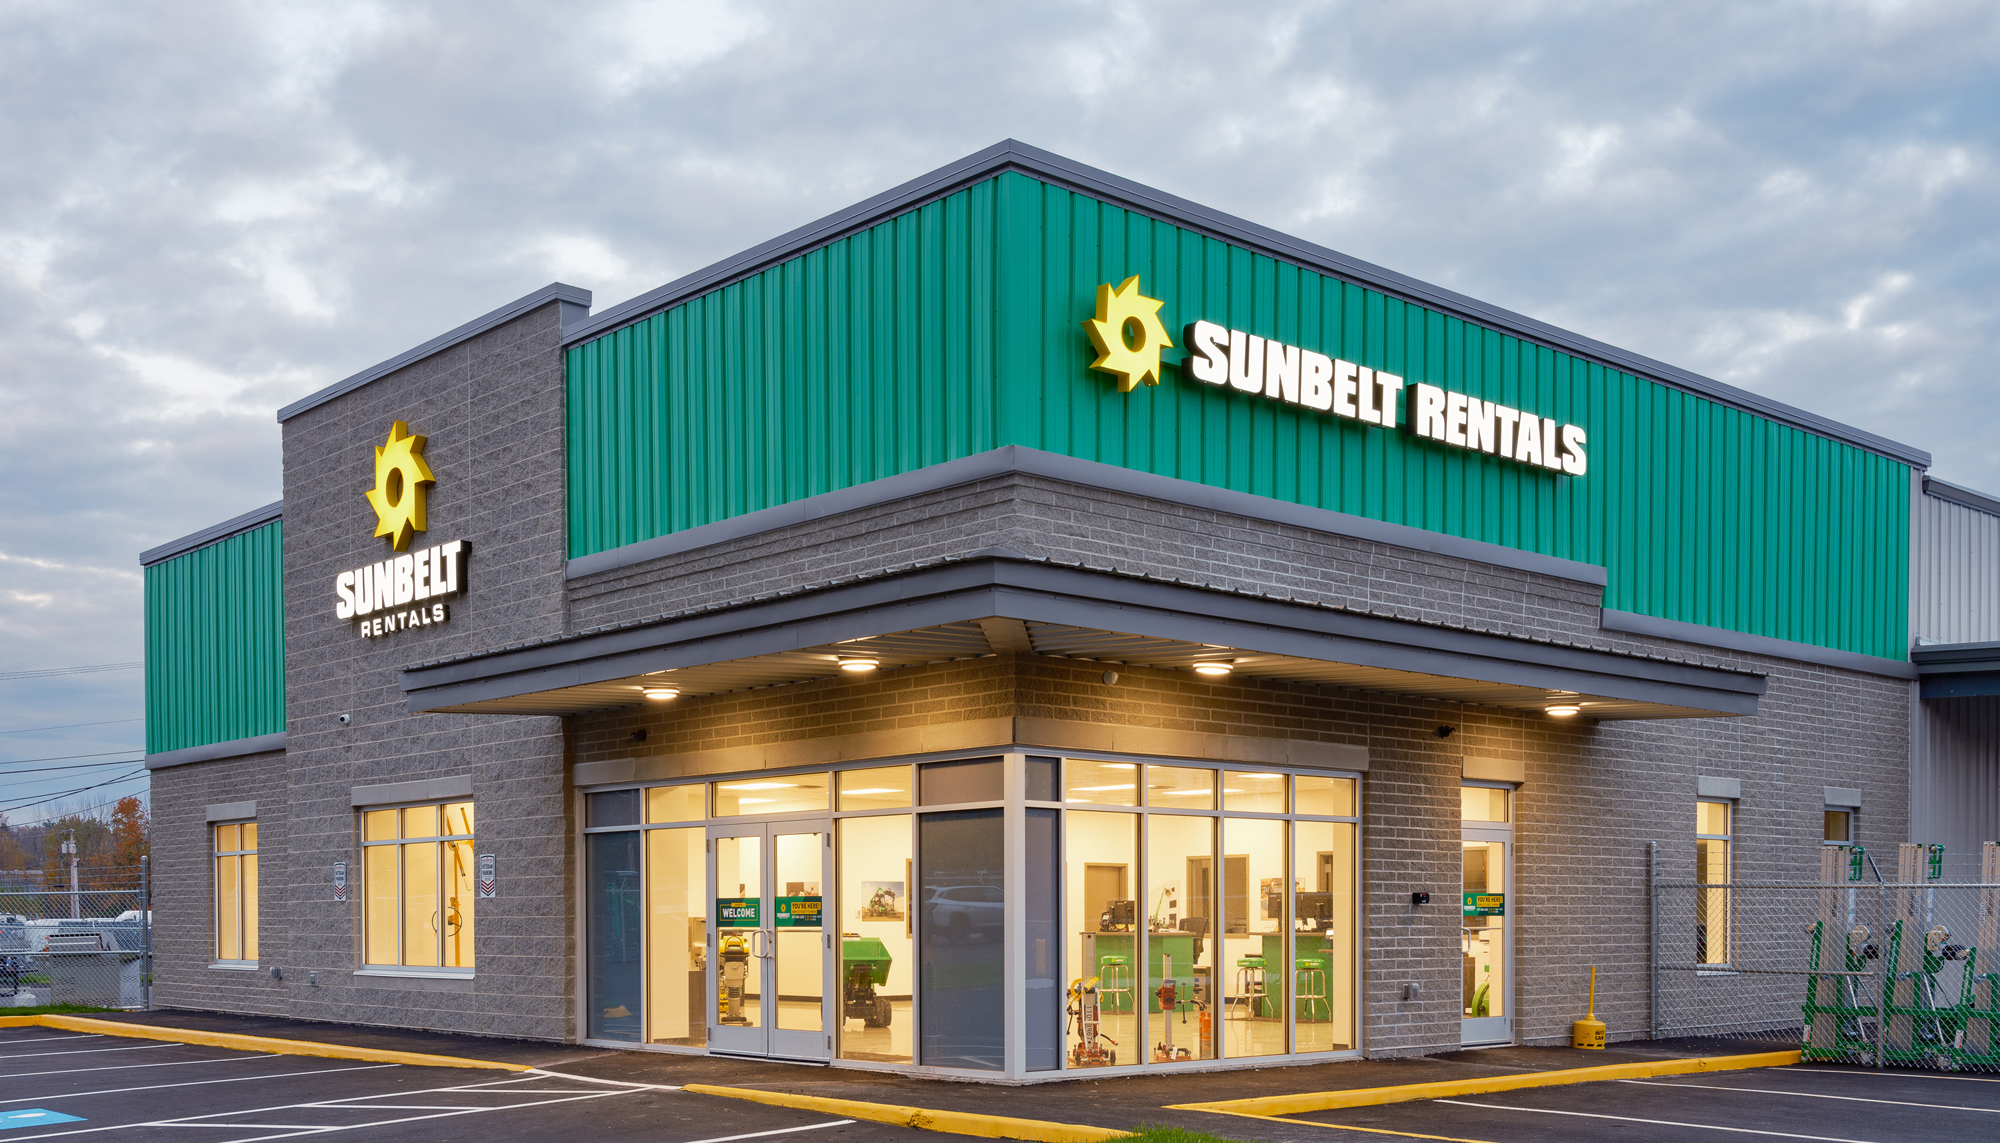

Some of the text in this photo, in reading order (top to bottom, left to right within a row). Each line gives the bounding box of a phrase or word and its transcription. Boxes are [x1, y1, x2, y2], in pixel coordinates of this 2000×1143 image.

[1190, 320, 1587, 477] SUNBELT RENTALS
[336, 539, 463, 619] SUNBELT
[360, 603, 445, 638] RENTALS
[722, 908, 755, 917] WELCOME
